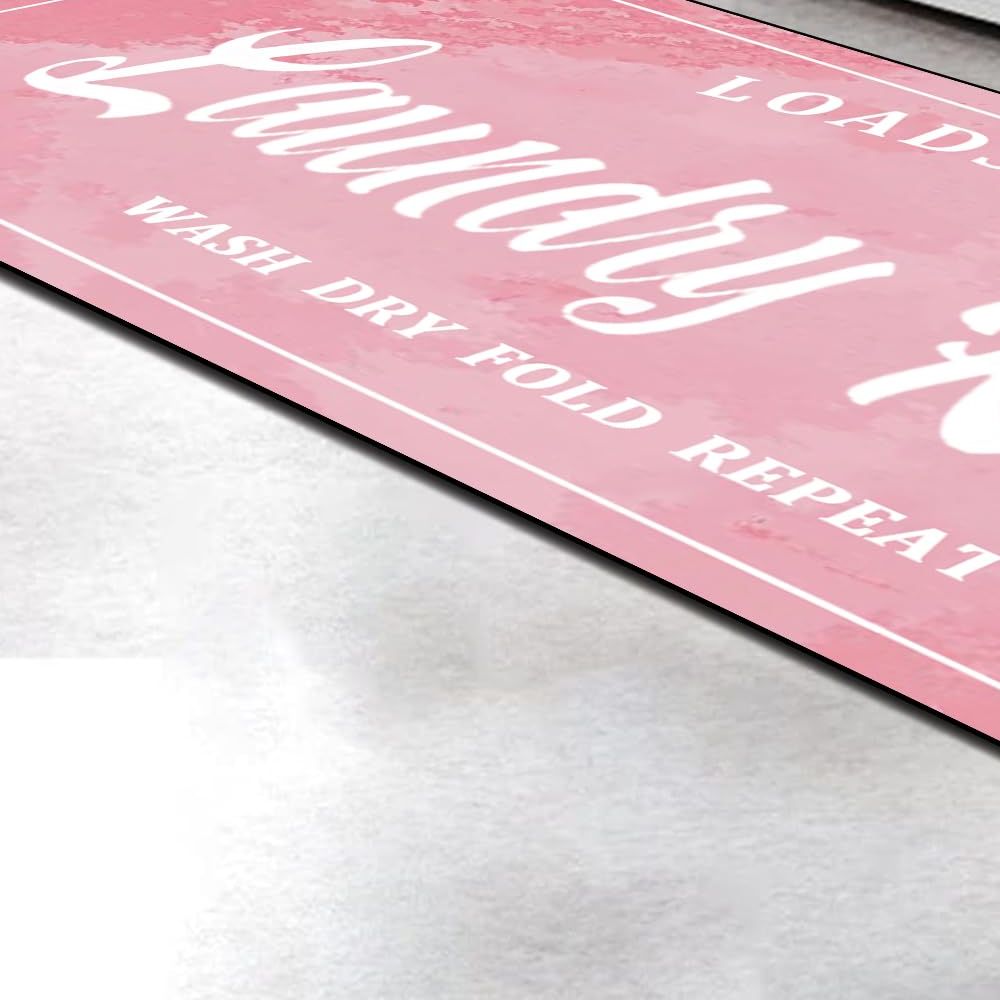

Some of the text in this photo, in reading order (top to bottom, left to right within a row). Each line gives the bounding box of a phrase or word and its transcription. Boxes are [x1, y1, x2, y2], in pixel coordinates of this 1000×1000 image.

[23, 27, 896, 335] Laundry
[124, 195, 312, 277] WASH
[301, 275, 469, 340] DRY
[455, 343, 664, 430] FOLD
